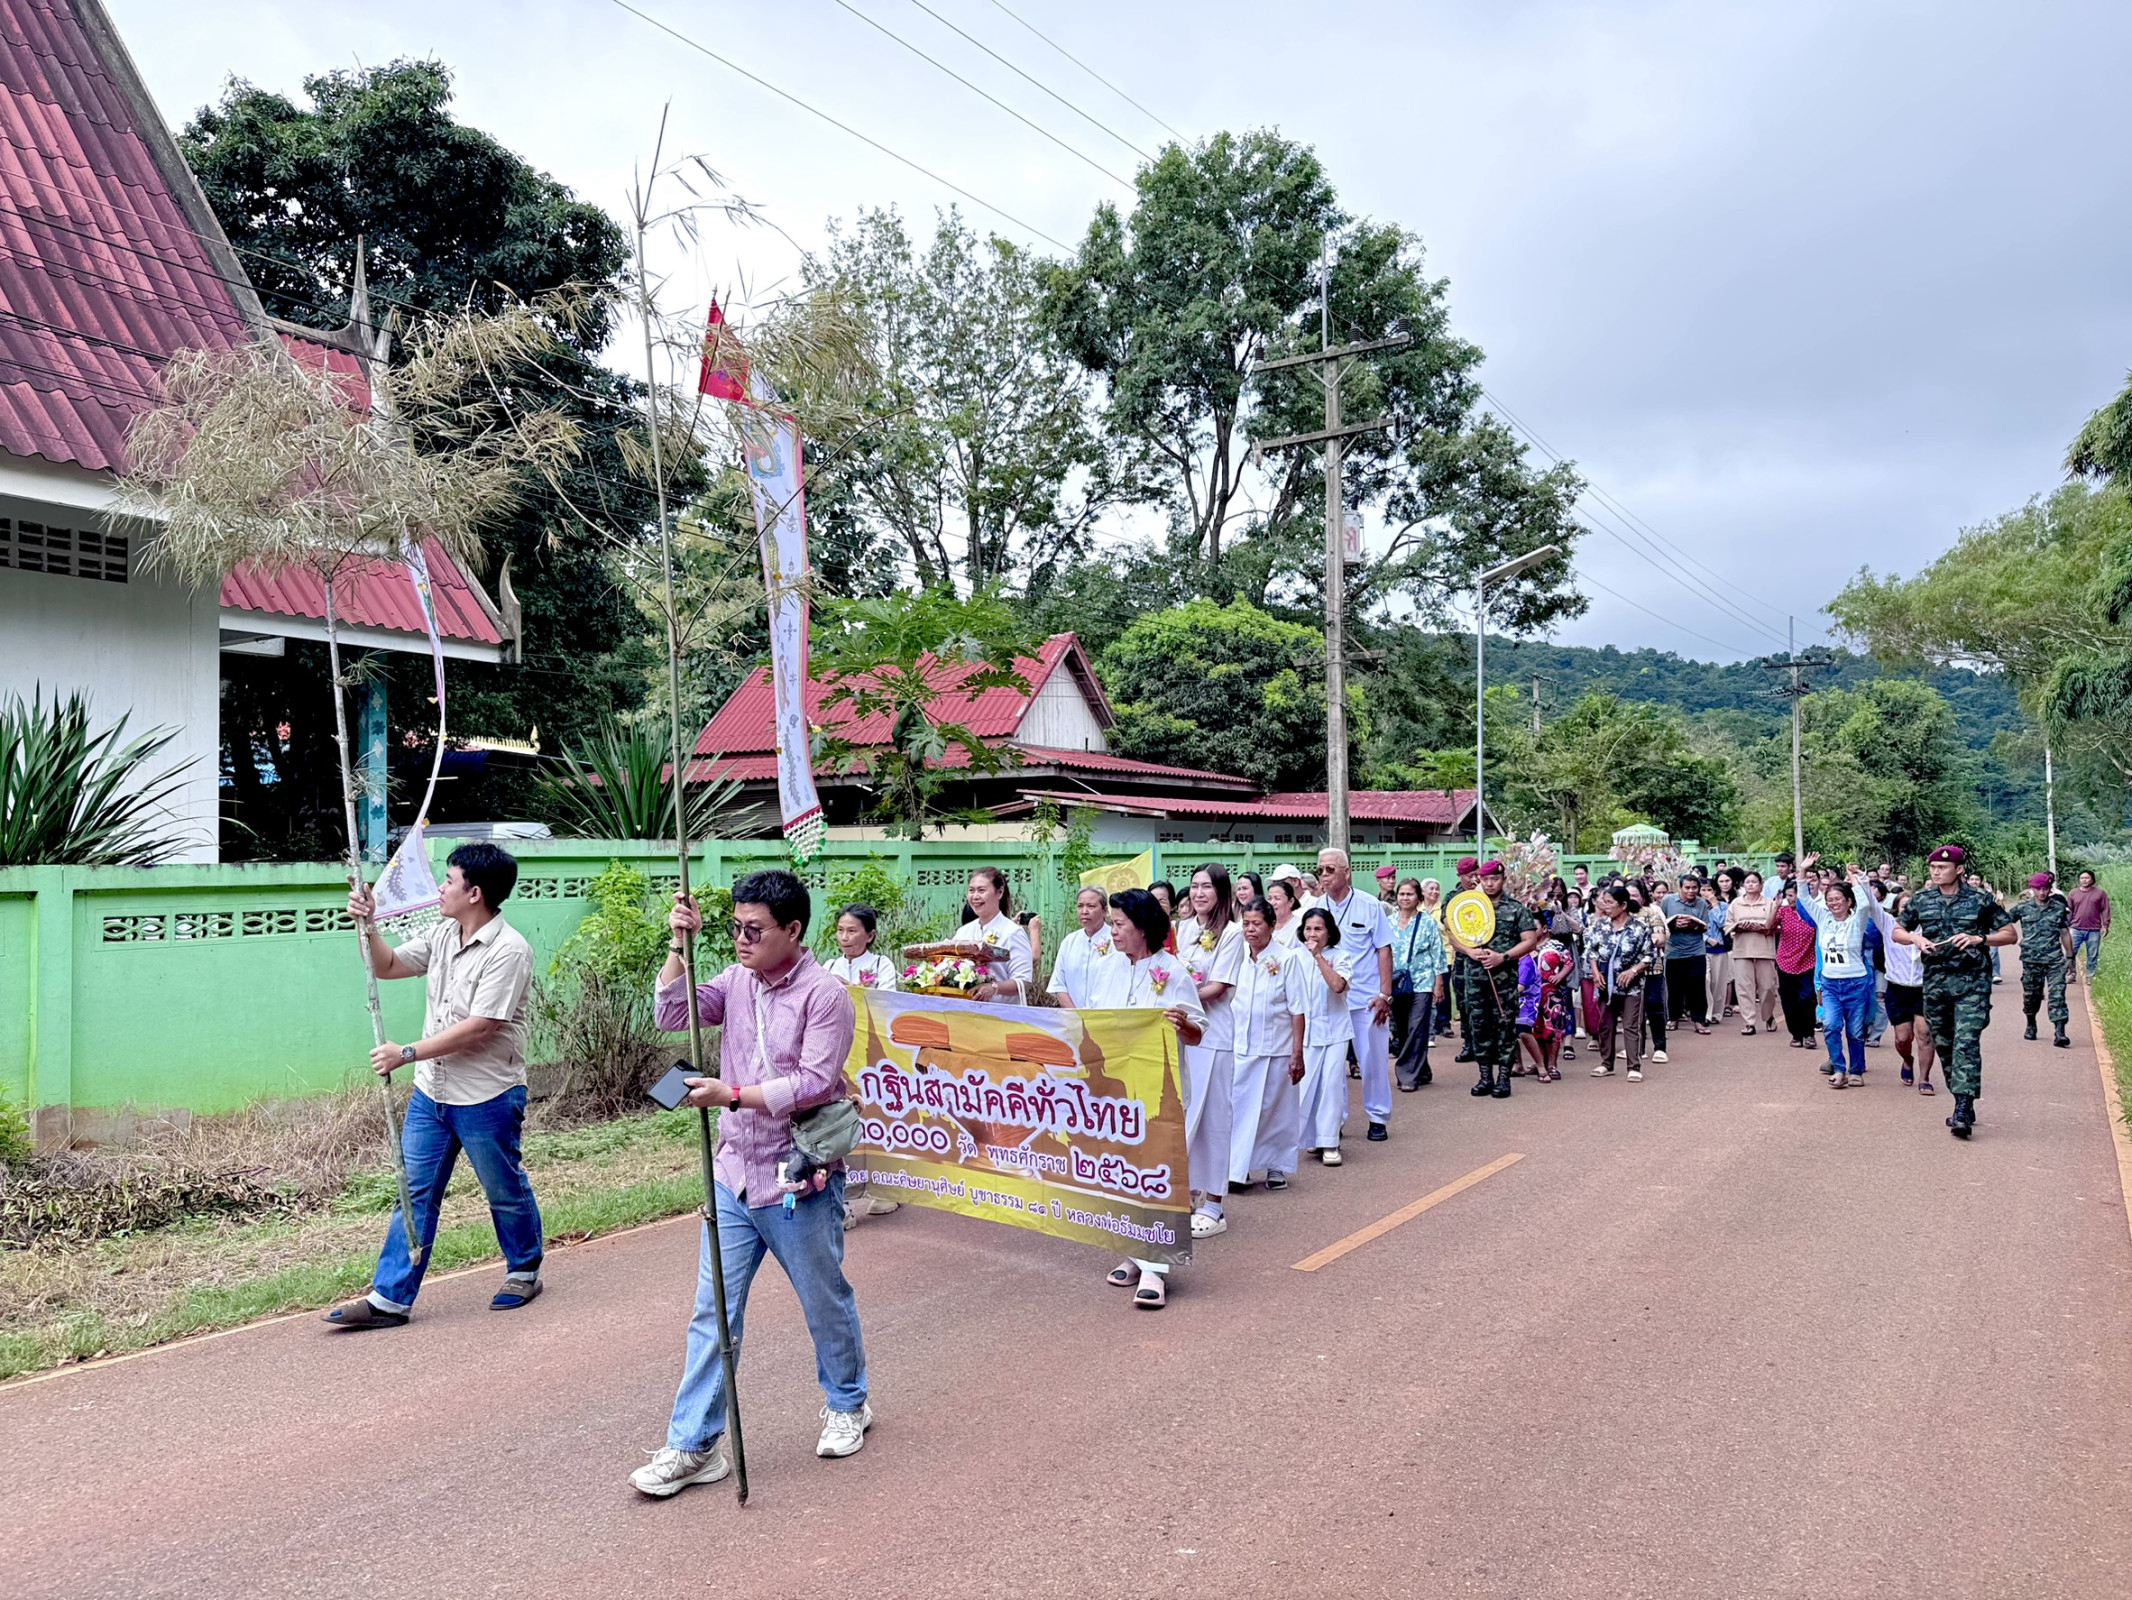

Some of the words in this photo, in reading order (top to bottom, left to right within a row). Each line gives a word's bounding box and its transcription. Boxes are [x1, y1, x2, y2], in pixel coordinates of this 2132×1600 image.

[861, 1064, 1140, 1139] กฐินสามัคคีทั่วไทย
[957, 1135, 977, 1157] วัด
[987, 1145, 1066, 1172] พุทธศักราช
[1073, 1150, 1168, 1194] ๒๕๖๘
[969, 1187, 1023, 1210] บูชาธรรม
[1051, 1200, 1062, 1218] ปี
[1066, 1208, 1175, 1244] หลวงพ่อธัมมชโย
